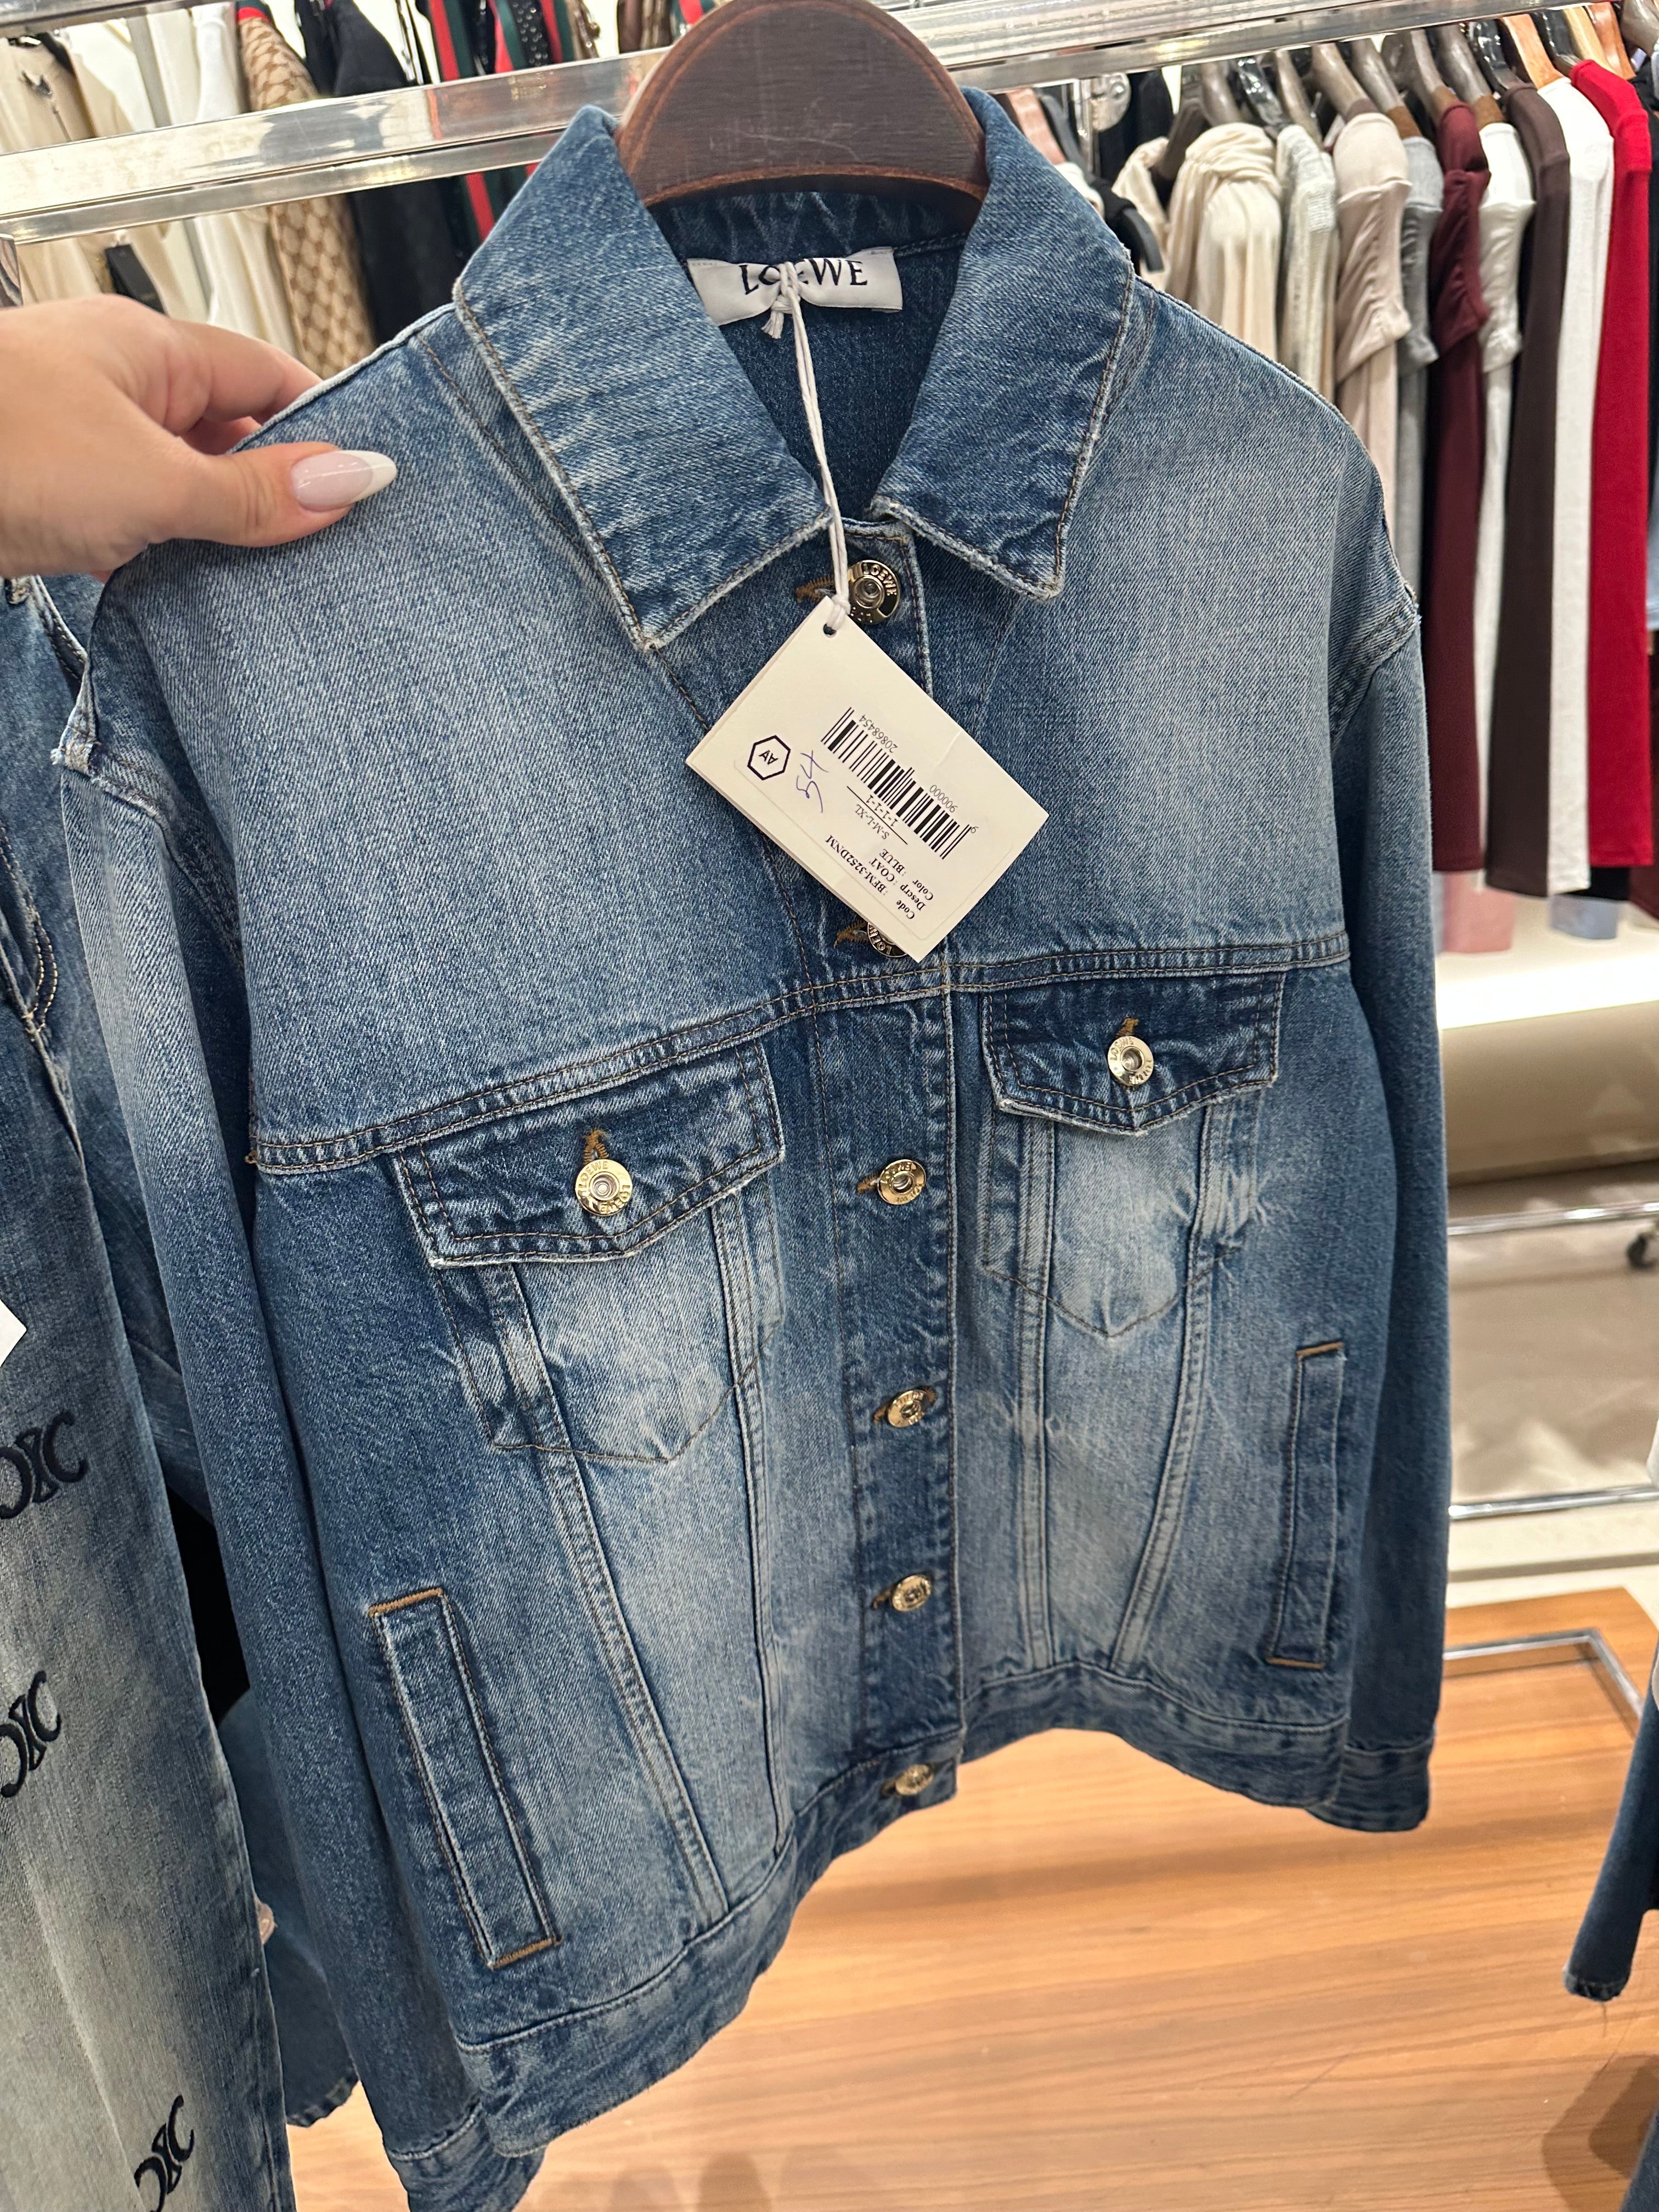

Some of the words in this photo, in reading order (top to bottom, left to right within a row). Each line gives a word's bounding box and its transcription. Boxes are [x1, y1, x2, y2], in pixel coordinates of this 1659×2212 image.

[859, 714, 898, 753] 20868454
[866, 794, 898, 827] 1-1-1-1
[929, 785, 958, 812] 900000
[855, 804, 890, 840] S-M-L-XL
[900, 884, 926, 911] Descrp
[912, 879, 934, 901] Color
[896, 900, 915, 919] Code
[578, 1161, 608, 1188] LOEWE
